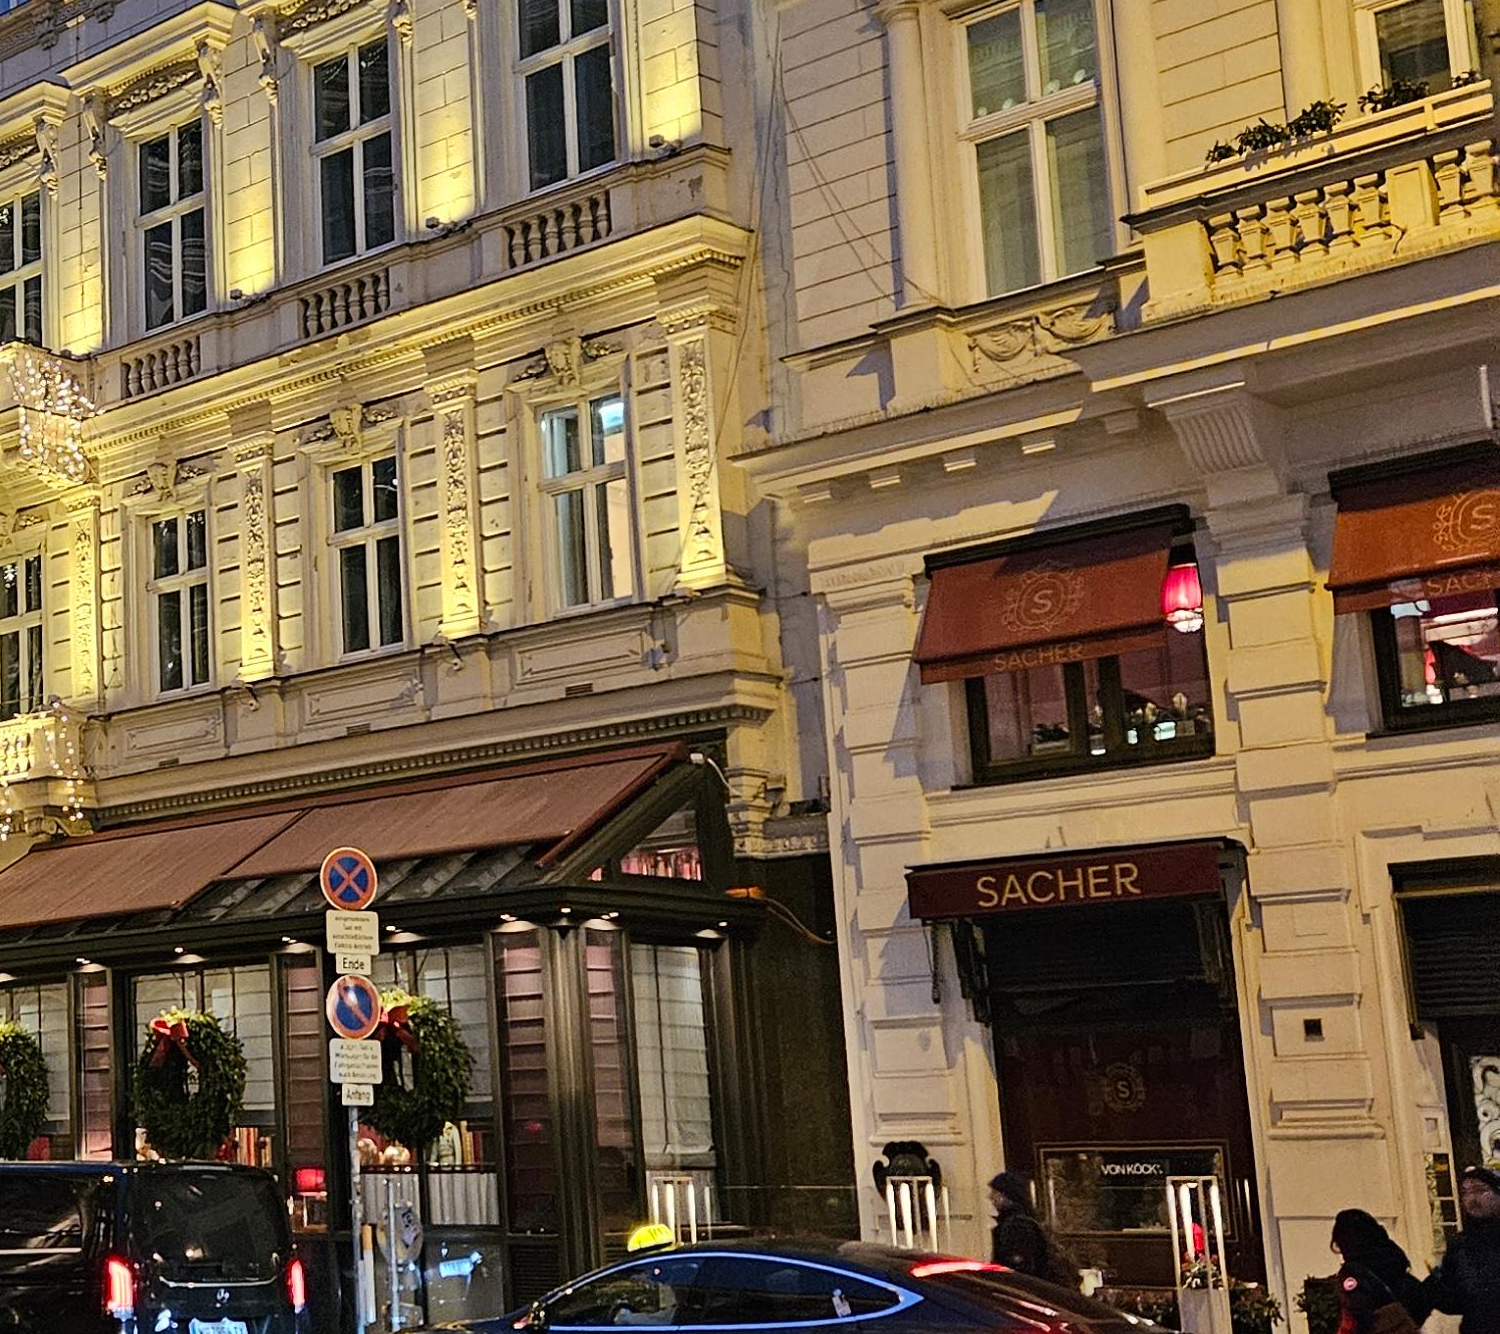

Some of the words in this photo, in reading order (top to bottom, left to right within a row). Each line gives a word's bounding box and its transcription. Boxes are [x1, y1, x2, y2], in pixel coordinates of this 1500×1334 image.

[994, 642, 1084, 671] SACHER
[976, 862, 1142, 908] SACHER
[342, 957, 365, 970] Ende
[346, 1088, 371, 1103] Anfang
